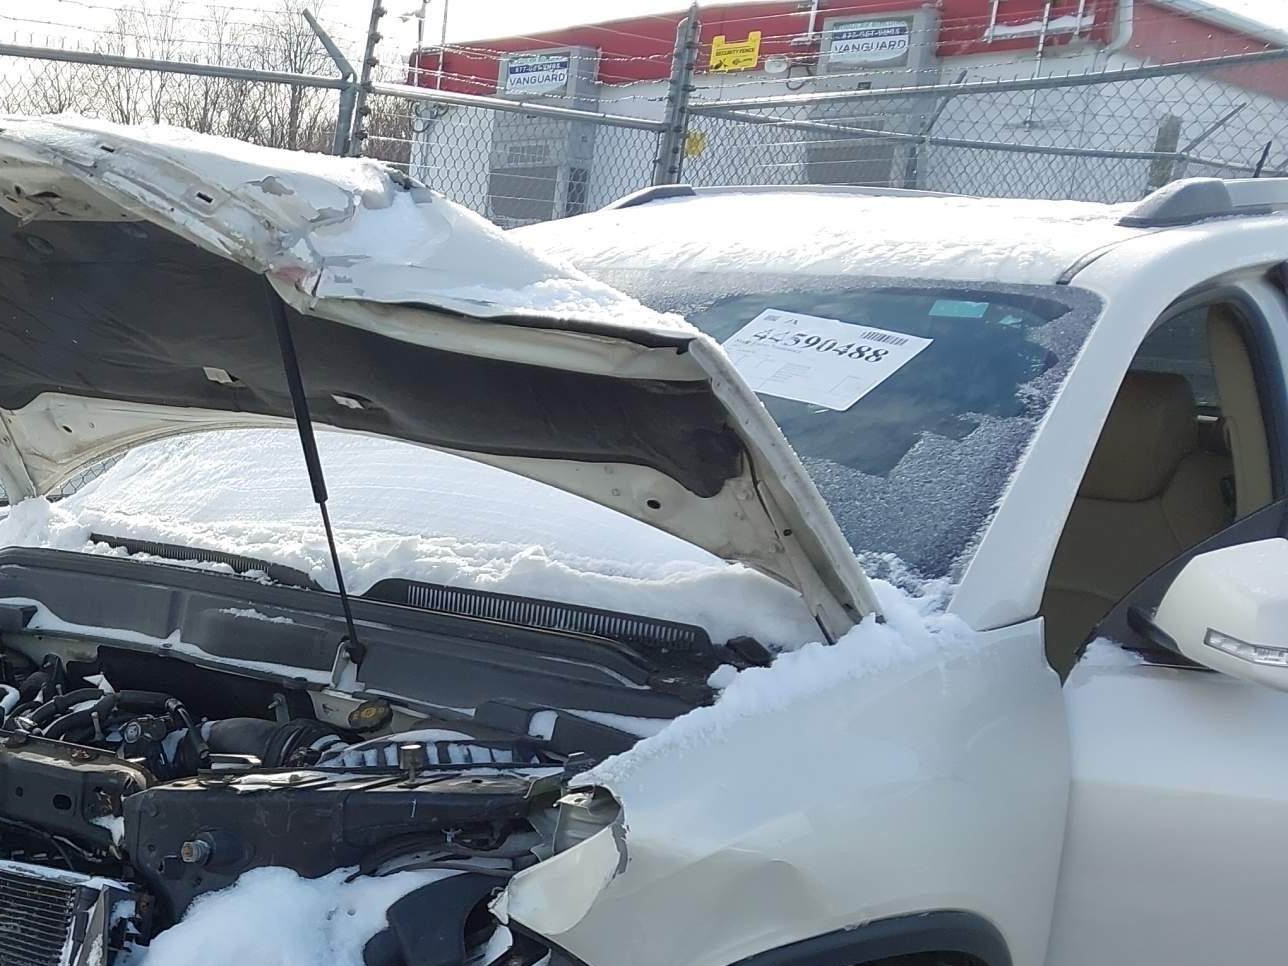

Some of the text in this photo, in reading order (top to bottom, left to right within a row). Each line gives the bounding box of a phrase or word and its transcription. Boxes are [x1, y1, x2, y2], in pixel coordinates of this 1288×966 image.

[834, 39, 906, 53] VANGUARD
[509, 72, 565, 86] VANGUARD
[752, 326, 890, 364] 44590488
